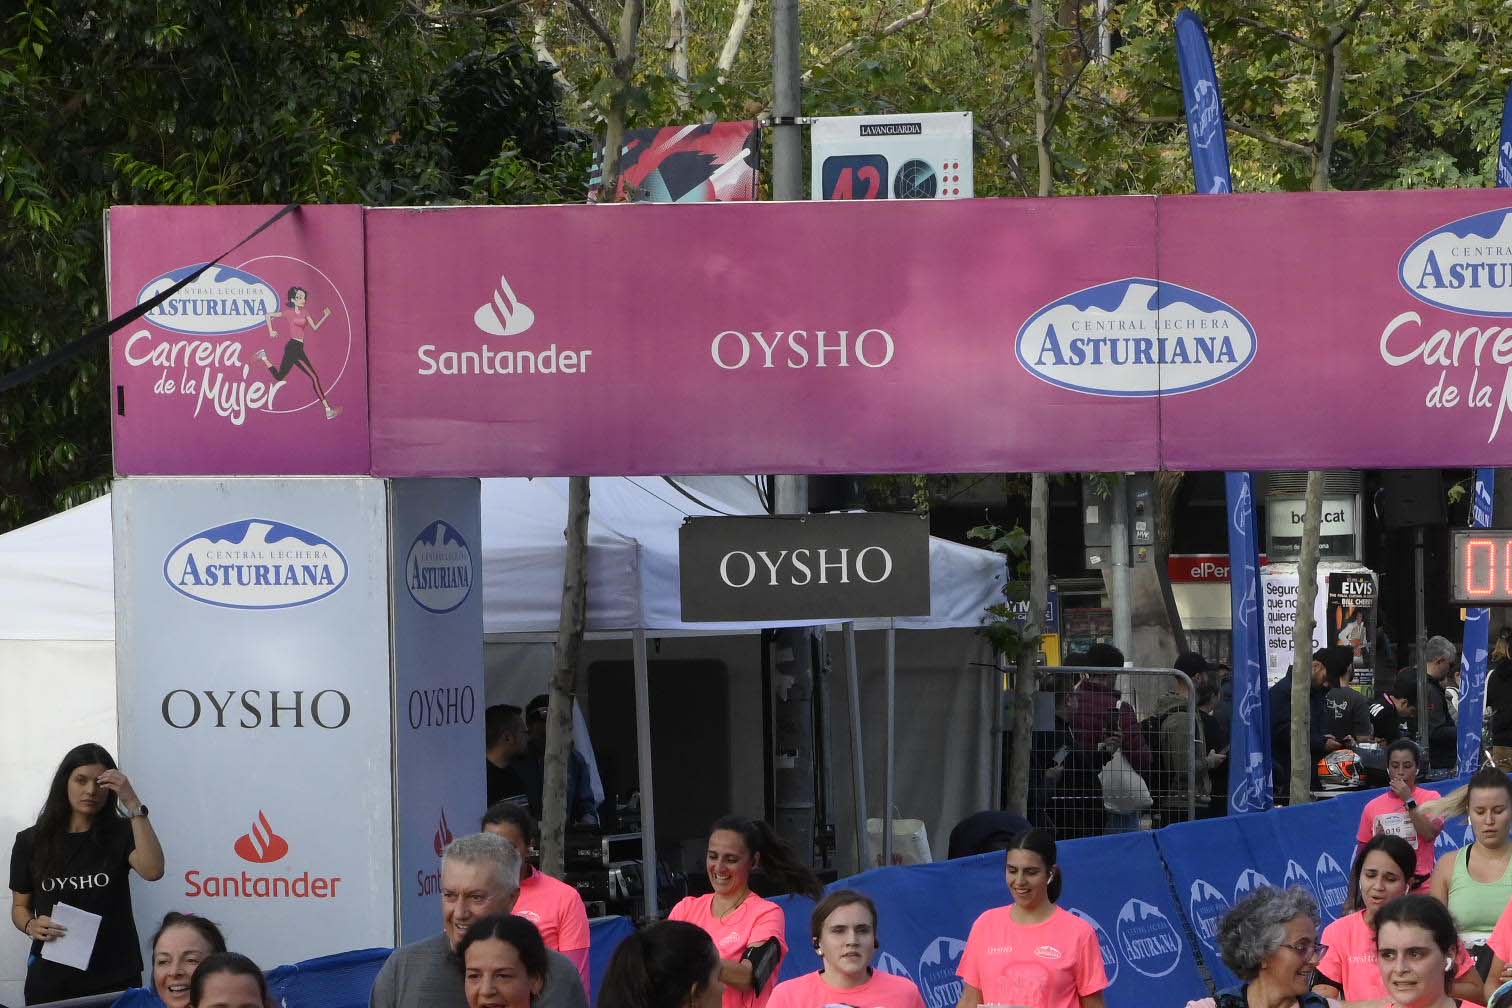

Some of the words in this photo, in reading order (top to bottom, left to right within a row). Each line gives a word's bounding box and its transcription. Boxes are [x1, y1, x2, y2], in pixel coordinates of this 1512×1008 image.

[1072, 320, 1145, 331] CENTRAL
[1154, 319, 1229, 330] LECHERA
[125, 330, 241, 367] Carrera
[418, 344, 592, 375] Santander
[711, 328, 895, 369] OYSHO
[1034, 323, 1238, 366] ASTURIANA
[154, 370, 176, 394] de
[181, 370, 196, 394] la
[194, 364, 287, 425] Mujer
[1425, 369, 1460, 408] de
[1468, 368, 1492, 408] la
[179, 553, 335, 586] ASTURIANA
[207, 551, 264, 560] CENTRAL
[270, 551, 328, 560] LECHERA
[411, 554, 469, 590] ASTURIANA
[719, 546, 893, 588] OYSHO
[1267, 599, 1286, 611] que
[1342, 582, 1372, 595] ELVIS
[1268, 638, 1287, 649] este
[161, 689, 351, 729] OYSHO
[409, 685, 475, 729] OYSHO
[42, 872, 110, 892] OYSHO
[185, 870, 342, 898] Santander
